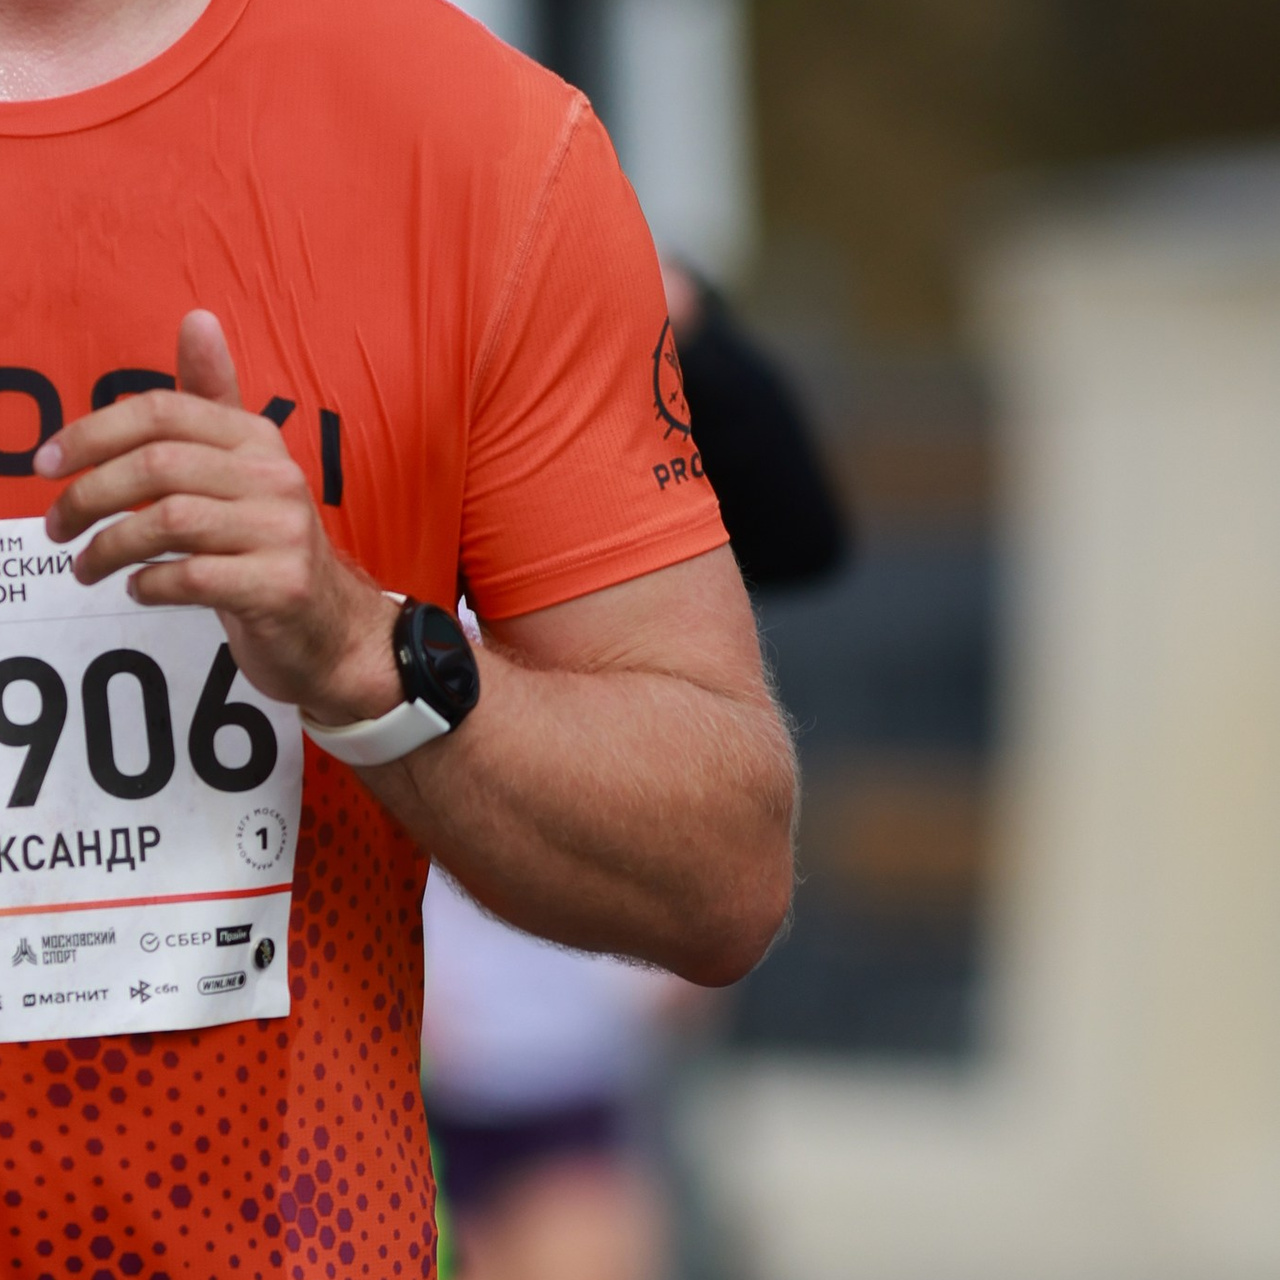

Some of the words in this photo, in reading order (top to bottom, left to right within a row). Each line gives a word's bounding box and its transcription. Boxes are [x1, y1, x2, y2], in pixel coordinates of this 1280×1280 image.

[255, 826, 269, 851] 1
[41, 927, 117, 949] МОСКОВСКИЙ
[165, 932, 213, 948] СБЕР
[42, 948, 78, 965] СПОРТ
[39, 988, 110, 1006] магнит
[154, 983, 180, 994] сбп
